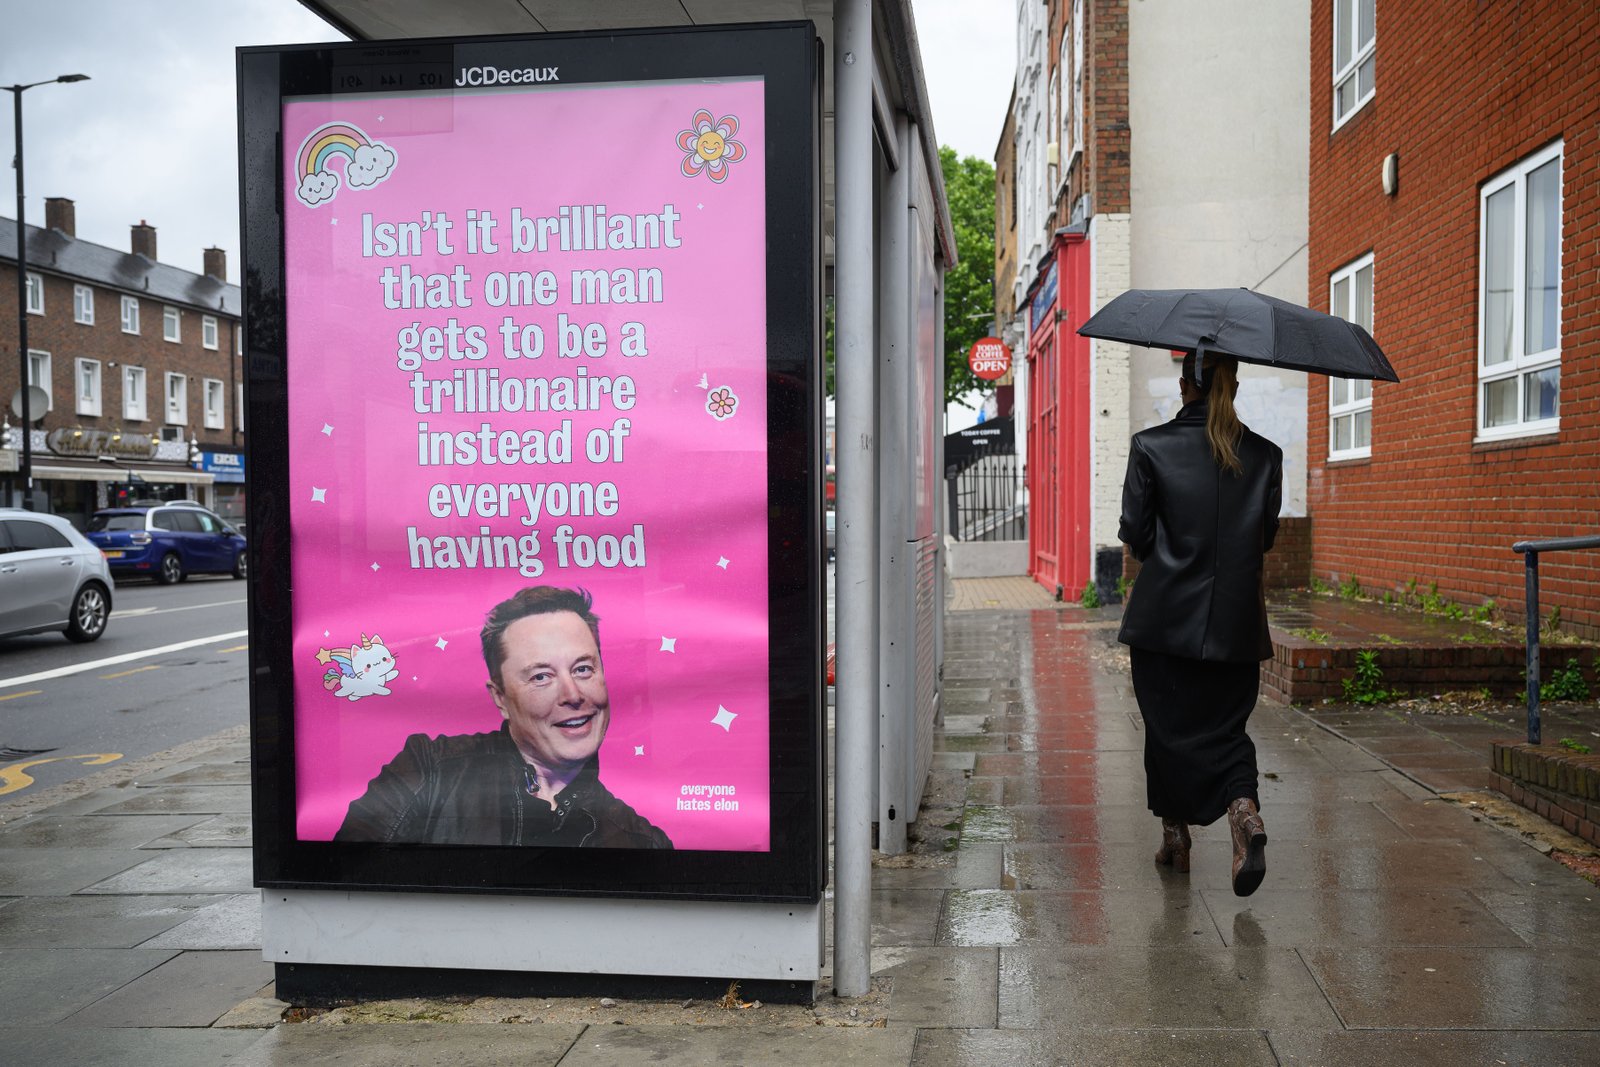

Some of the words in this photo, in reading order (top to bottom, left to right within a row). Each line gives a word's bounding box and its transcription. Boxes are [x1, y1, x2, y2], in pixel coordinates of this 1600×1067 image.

[455, 66, 560, 87] JCDecaux
[467, 210, 498, 254] it
[511, 204, 681, 253] brilliant
[379, 265, 472, 310] that
[484, 271, 558, 308] one
[572, 267, 663, 305] man
[397, 317, 488, 374] gets
[499, 317, 544, 360] to
[558, 313, 607, 359] be
[621, 322, 648, 357] a
[973, 361, 1007, 371] OPEN
[410, 366, 637, 414] trillionaire
[417, 419, 572, 466] instead
[586, 418, 631, 464] of
[428, 482, 619, 526] everyone
[407, 526, 544, 578] having
[552, 524, 646, 569] food
[677, 798, 711, 811] hates
[713, 797, 739, 811] elon
[681, 785, 735, 798] everyone
